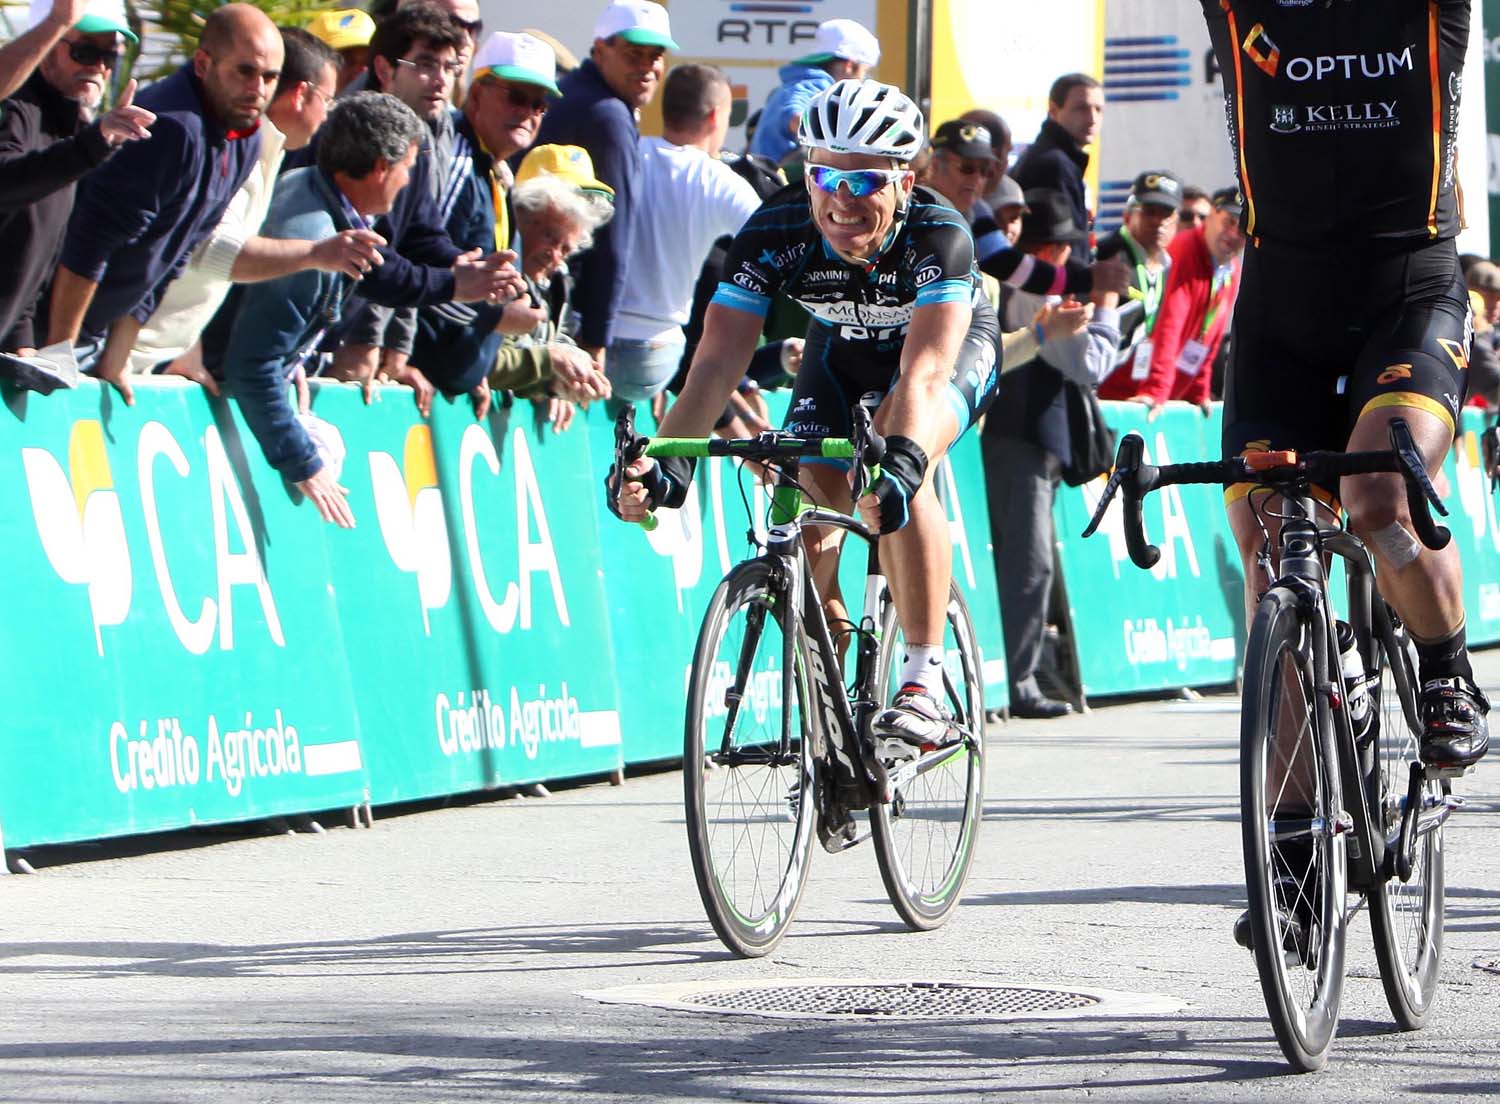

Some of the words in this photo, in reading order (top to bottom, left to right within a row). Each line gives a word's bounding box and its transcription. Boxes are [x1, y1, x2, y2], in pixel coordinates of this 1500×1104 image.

[1285, 46, 1414, 82] OPTUM
[1304, 99, 1398, 123] KELLY
[739, 275, 763, 293] KIA
[915, 268, 937, 284] KIA
[136, 419, 286, 655] CA
[458, 423, 571, 634] CA
[435, 689, 506, 758] Crédito
[509, 680, 581, 760] Agrícola
[109, 717, 200, 794] Crédito
[205, 707, 302, 798] Agrícola
